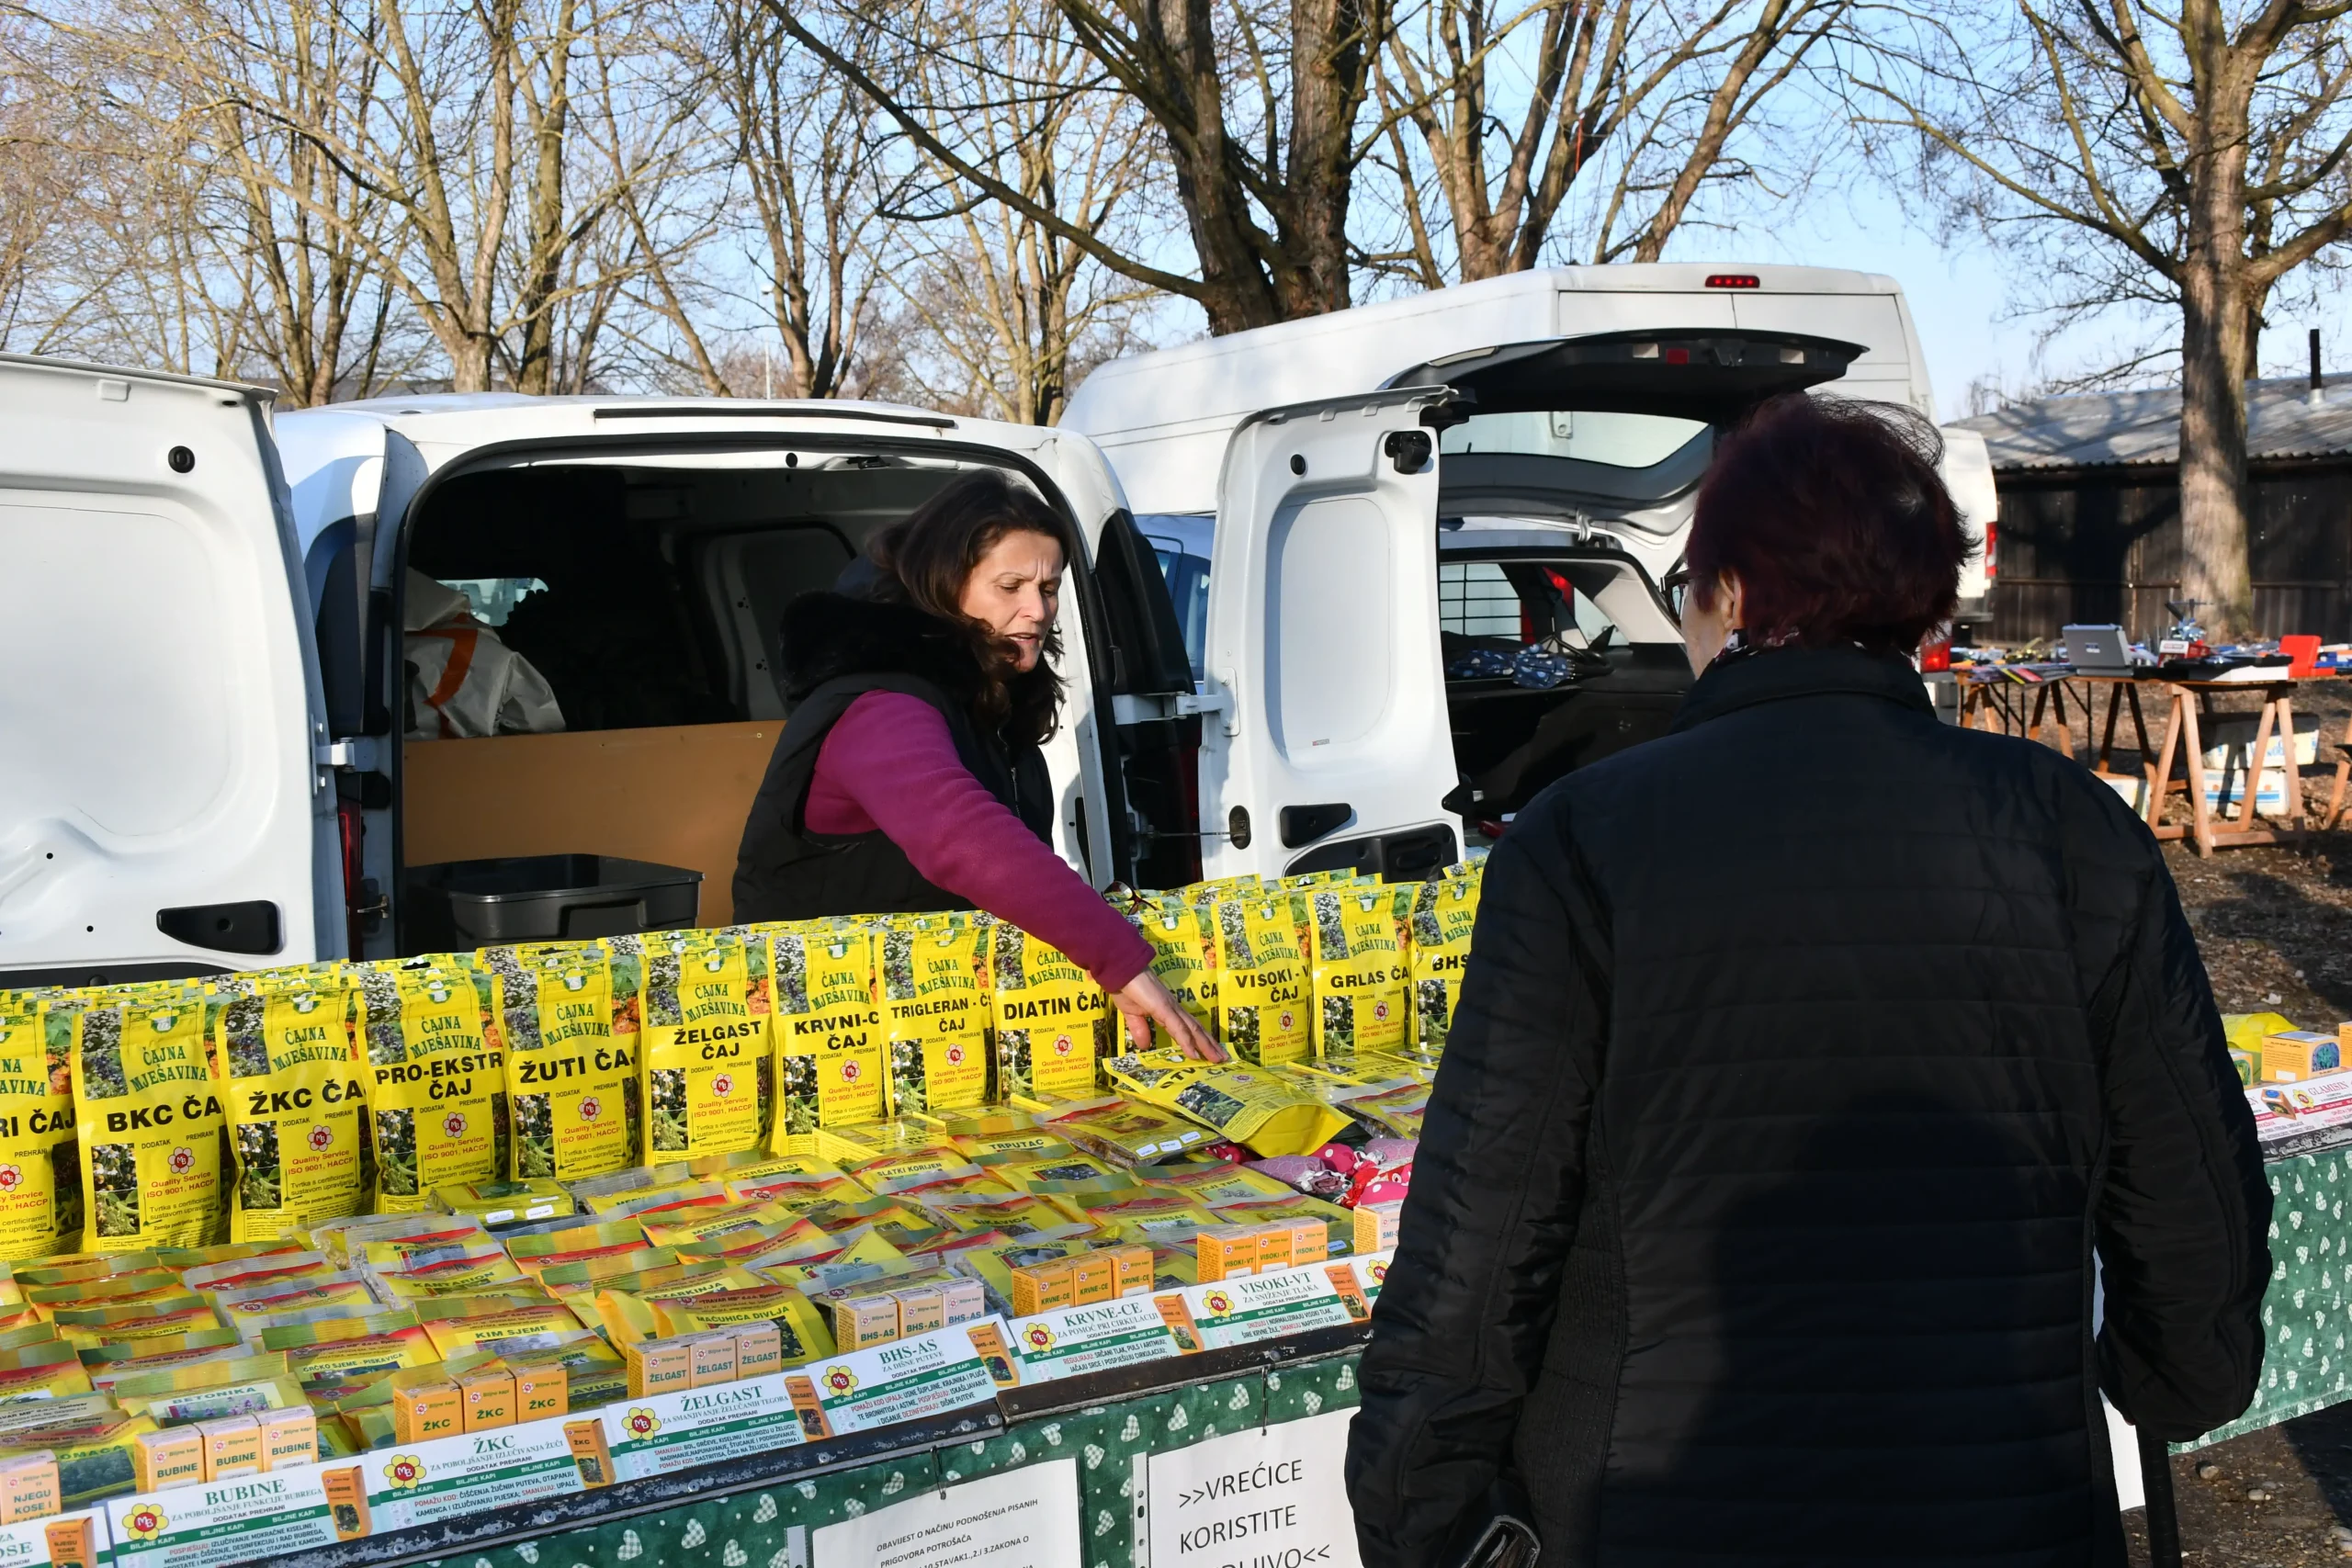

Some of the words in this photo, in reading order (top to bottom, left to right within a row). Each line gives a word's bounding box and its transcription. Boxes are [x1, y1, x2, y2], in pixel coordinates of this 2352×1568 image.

[1259, 931, 1283, 946] ČAJNA
[1355, 923, 1381, 937] ČAJNA
[1158, 941, 1186, 956] ČAJNA
[1350, 937, 1396, 956] MJEŠAVINA
[1036, 951, 1069, 965] ČAJNA
[1256, 945, 1299, 967] MJEŠAVINA
[1433, 954, 1469, 971] BHS
[928, 958, 958, 974] ČAJNA
[1153, 955, 1204, 976] MJEŠAVINA
[821, 971, 855, 987] ČAJNA
[918, 972, 975, 997] MJEŠAVINA
[1028, 964, 1083, 987] MJEŠAVINA
[1236, 969, 1292, 988] VISOKI
[1330, 971, 1385, 988] GRLAS
[1391, 965, 1409, 981] ČA
[695, 983, 728, 999] ČAJNA
[811, 986, 870, 1010] MJEŠAVINA
[1271, 986, 1298, 1002] ČAJ
[557, 1003, 594, 1021] ČAJNA
[685, 998, 746, 1022] MJEŠAVINA
[891, 997, 968, 1020] TRIGLERAN
[1003, 998, 1070, 1020] DIATIN
[1077, 991, 1107, 1011] ČAJ
[421, 1015, 461, 1034] ČAJNA
[795, 1010, 879, 1035] KRVNI-C
[939, 1018, 965, 1033] ČAJ
[285, 1027, 326, 1046] ČAJNA
[545, 1021, 610, 1045] MJEŠAVINA
[673, 1021, 762, 1045] ŽELGAST
[828, 1032, 867, 1051] ČAJ
[926, 1036, 946, 1044] DODATAK
[410, 1032, 481, 1059] MJEŠAVINA
[702, 1043, 740, 1060] ČAJ
[142, 1046, 186, 1066] ČAJNA
[272, 1043, 347, 1072] MJEŠAVINA
[376, 1051, 503, 1085] PRO-EKSTR
[519, 1056, 586, 1084] ŽUTI
[595, 1048, 636, 1071] ČA
[691, 1065, 714, 1074] DODATAK
[727, 1061, 752, 1069] PREHRANI
[130, 1064, 208, 1092] MJEŠAVINA
[249, 1089, 312, 1115] ŽKC
[322, 1078, 366, 1103] ČA
[429, 1078, 471, 1100] ČAJ
[694, 1110, 707, 1118] ISO
[709, 1108, 727, 1116] 9001,
[729, 1103, 752, 1112] HACCP
[697, 1100, 722, 1109] Quality
[724, 1097, 748, 1105] Service
[29, 1109, 75, 1134] ČAJ
[107, 1104, 173, 1133] BKC
[183, 1095, 222, 1120] ČA
[283, 1118, 311, 1127] DODATAK
[324, 1110, 353, 1120] PREHRANI
[141, 1139, 171, 1149] DODATAK
[186, 1131, 214, 1141] PREHRANI
[989, 1139, 1045, 1150] TRPUTAC
[288, 1166, 303, 1175] ISO
[305, 1162, 325, 1172] 9001,
[328, 1157, 354, 1168] HACCP
[292, 1156, 321, 1166] Quality
[322, 1149, 349, 1160] Service
[777, 1163, 799, 1171] LIST
[877, 1167, 907, 1177] SLATKI
[909, 1162, 942, 1172] KORIJEN
[147, 1190, 163, 1199] ISO
[164, 1186, 187, 1196] 9001,
[189, 1179, 215, 1191] HACCP
[151, 1178, 181, 1189] Quality
[184, 1171, 210, 1182] Service
[290, 1180, 311, 1189] Tvrtka
[319, 1171, 355, 1184] certificiranim
[291, 1187, 322, 1196] sustavom
[323, 1179, 355, 1191] upravljanja
[1261, 1250, 1290, 1260] VISOKI-VT
[1296, 1245, 1325, 1255] VISOKI-VT
[1224, 1258, 1254, 1268] VISOKI-VT
[413, 1271, 495, 1289] KANTARION
[1122, 1274, 1149, 1285] KRVNE-CE
[1239, 1271, 1313, 1294] VISOKI-VT
[1080, 1283, 1108, 1295] KRVNE-CE
[1243, 1295, 1254, 1303] ZA
[1254, 1288, 1293, 1303] SNIŽENJE
[1294, 1283, 1319, 1296] TLAKA
[1041, 1292, 1069, 1305] KRVNE-CE
[753, 1306, 789, 1319] DIVLJA
[948, 1311, 981, 1324] BHS-AS
[1064, 1302, 1143, 1327] KRVNE-CE
[475, 1330, 503, 1338] KIM
[507, 1325, 548, 1336] SJEME
[906, 1320, 940, 1333] BHS-AS
[1057, 1330, 1068, 1338] ZA
[1069, 1325, 1096, 1337] POMOĆ
[1097, 1323, 1110, 1331] PRI
[1111, 1313, 1159, 1328] CIRKULACIJI
[861, 1328, 895, 1342] BHS-AS
[742, 1351, 777, 1365] ŽELGAST
[877, 1338, 938, 1365] BHS-AS
[303, 1364, 330, 1372] GRČKO
[332, 1360, 357, 1369] SJEME
[363, 1352, 404, 1365] PISKAVICA
[696, 1360, 733, 1375] ŽELGAST
[882, 1365, 892, 1373] ZA
[893, 1358, 912, 1371] DIŠNE
[913, 1350, 944, 1366] PUTEVE
[891, 1369, 918, 1379] DODATAK
[919, 1360, 945, 1371] PREHRANI
[650, 1370, 686, 1382] ŽELGAST
[173, 1385, 256, 1404] BETONIKA
[681, 1385, 763, 1413] ŽELGAST
[851, 1401, 873, 1413] POMAŽU
[874, 1399, 885, 1407] KOD
[886, 1393, 904, 1404] UPALA:
[903, 1390, 918, 1400] USNE
[943, 1378, 966, 1388] KRAJNIKA
[969, 1370, 987, 1381] PLUĆA
[529, 1398, 556, 1410] ŽKC
[673, 1409, 719, 1423] SMANJIVANJE
[720, 1401, 760, 1414] ŽELUČANIH
[762, 1395, 789, 1407] TEGOBA
[477, 1407, 504, 1420] ŽKC
[424, 1418, 451, 1432] ŽKC
[272, 1441, 311, 1456] BUBINE
[473, 1435, 517, 1455] ŽKC
[216, 1451, 256, 1467] BUBINE
[429, 1463, 441, 1472] ZA
[442, 1453, 494, 1470] POBOLJŠANJE
[494, 1444, 544, 1461] IZLUČIVANJA
[545, 1439, 563, 1451] ŽUČI
[157, 1462, 198, 1478] BUBINE
[14, 1489, 51, 1504] NJEGU
[205, 1478, 287, 1506] BUBINE
[15, 1502, 45, 1515] KOSE
[171, 1514, 184, 1522] ZA
[185, 1503, 243, 1518] POBOLJŠANJE
[243, 1495, 283, 1510] FUNKCIJE
[285, 1488, 323, 1502] BUBREGA
[876, 1532, 916, 1552] OBAVIJEST
[917, 1530, 923, 1539] O
[924, 1520, 955, 1536] NAČINU
[956, 1506, 1007, 1528] PODNOŠENJA
[1007, 1498, 1038, 1513] PISANIH
[1181, 1505, 1296, 1554] KORISTITE
[984, 1538, 1022, 1555] 3.ZAKONA
[880, 1549, 925, 1568] PRIGOVORA
